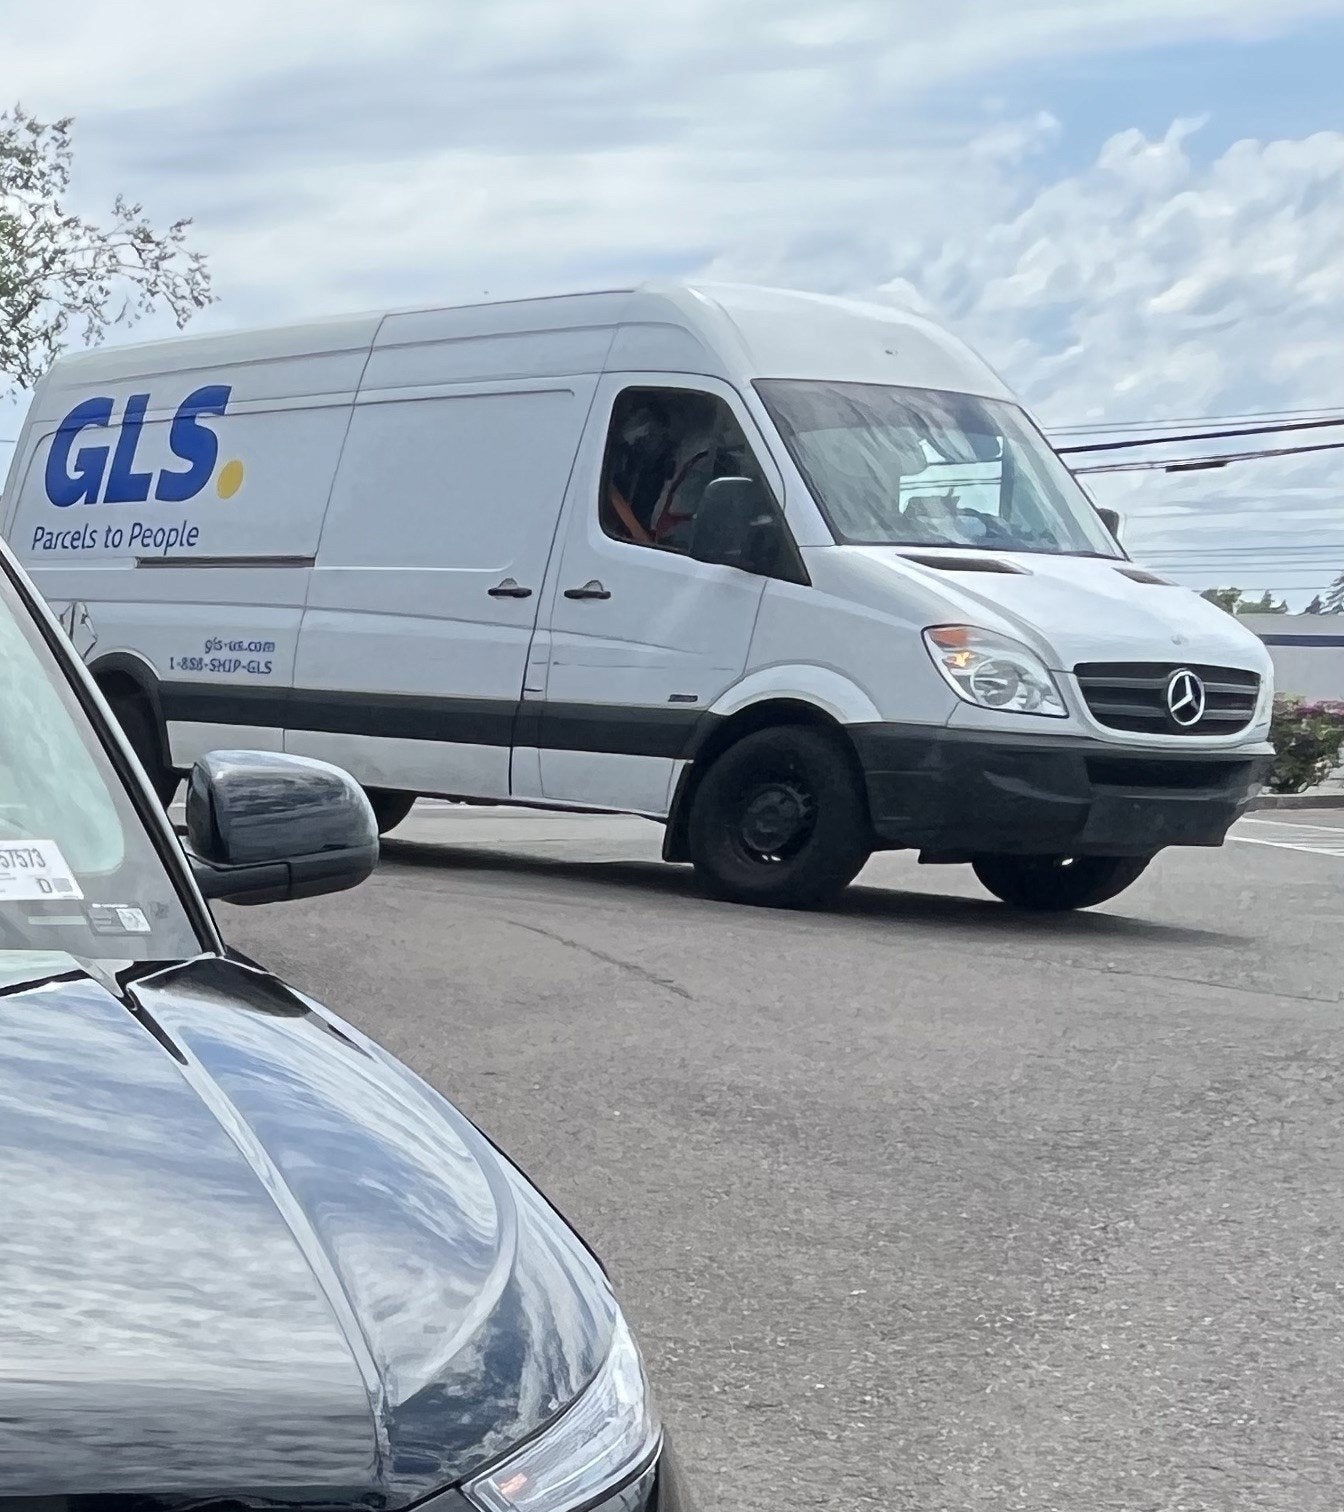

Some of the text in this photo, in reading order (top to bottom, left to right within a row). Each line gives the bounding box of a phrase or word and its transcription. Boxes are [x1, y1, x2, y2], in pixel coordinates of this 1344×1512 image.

[44, 385, 233, 508] GLS
[32, 520, 200, 556] Parcels to People
